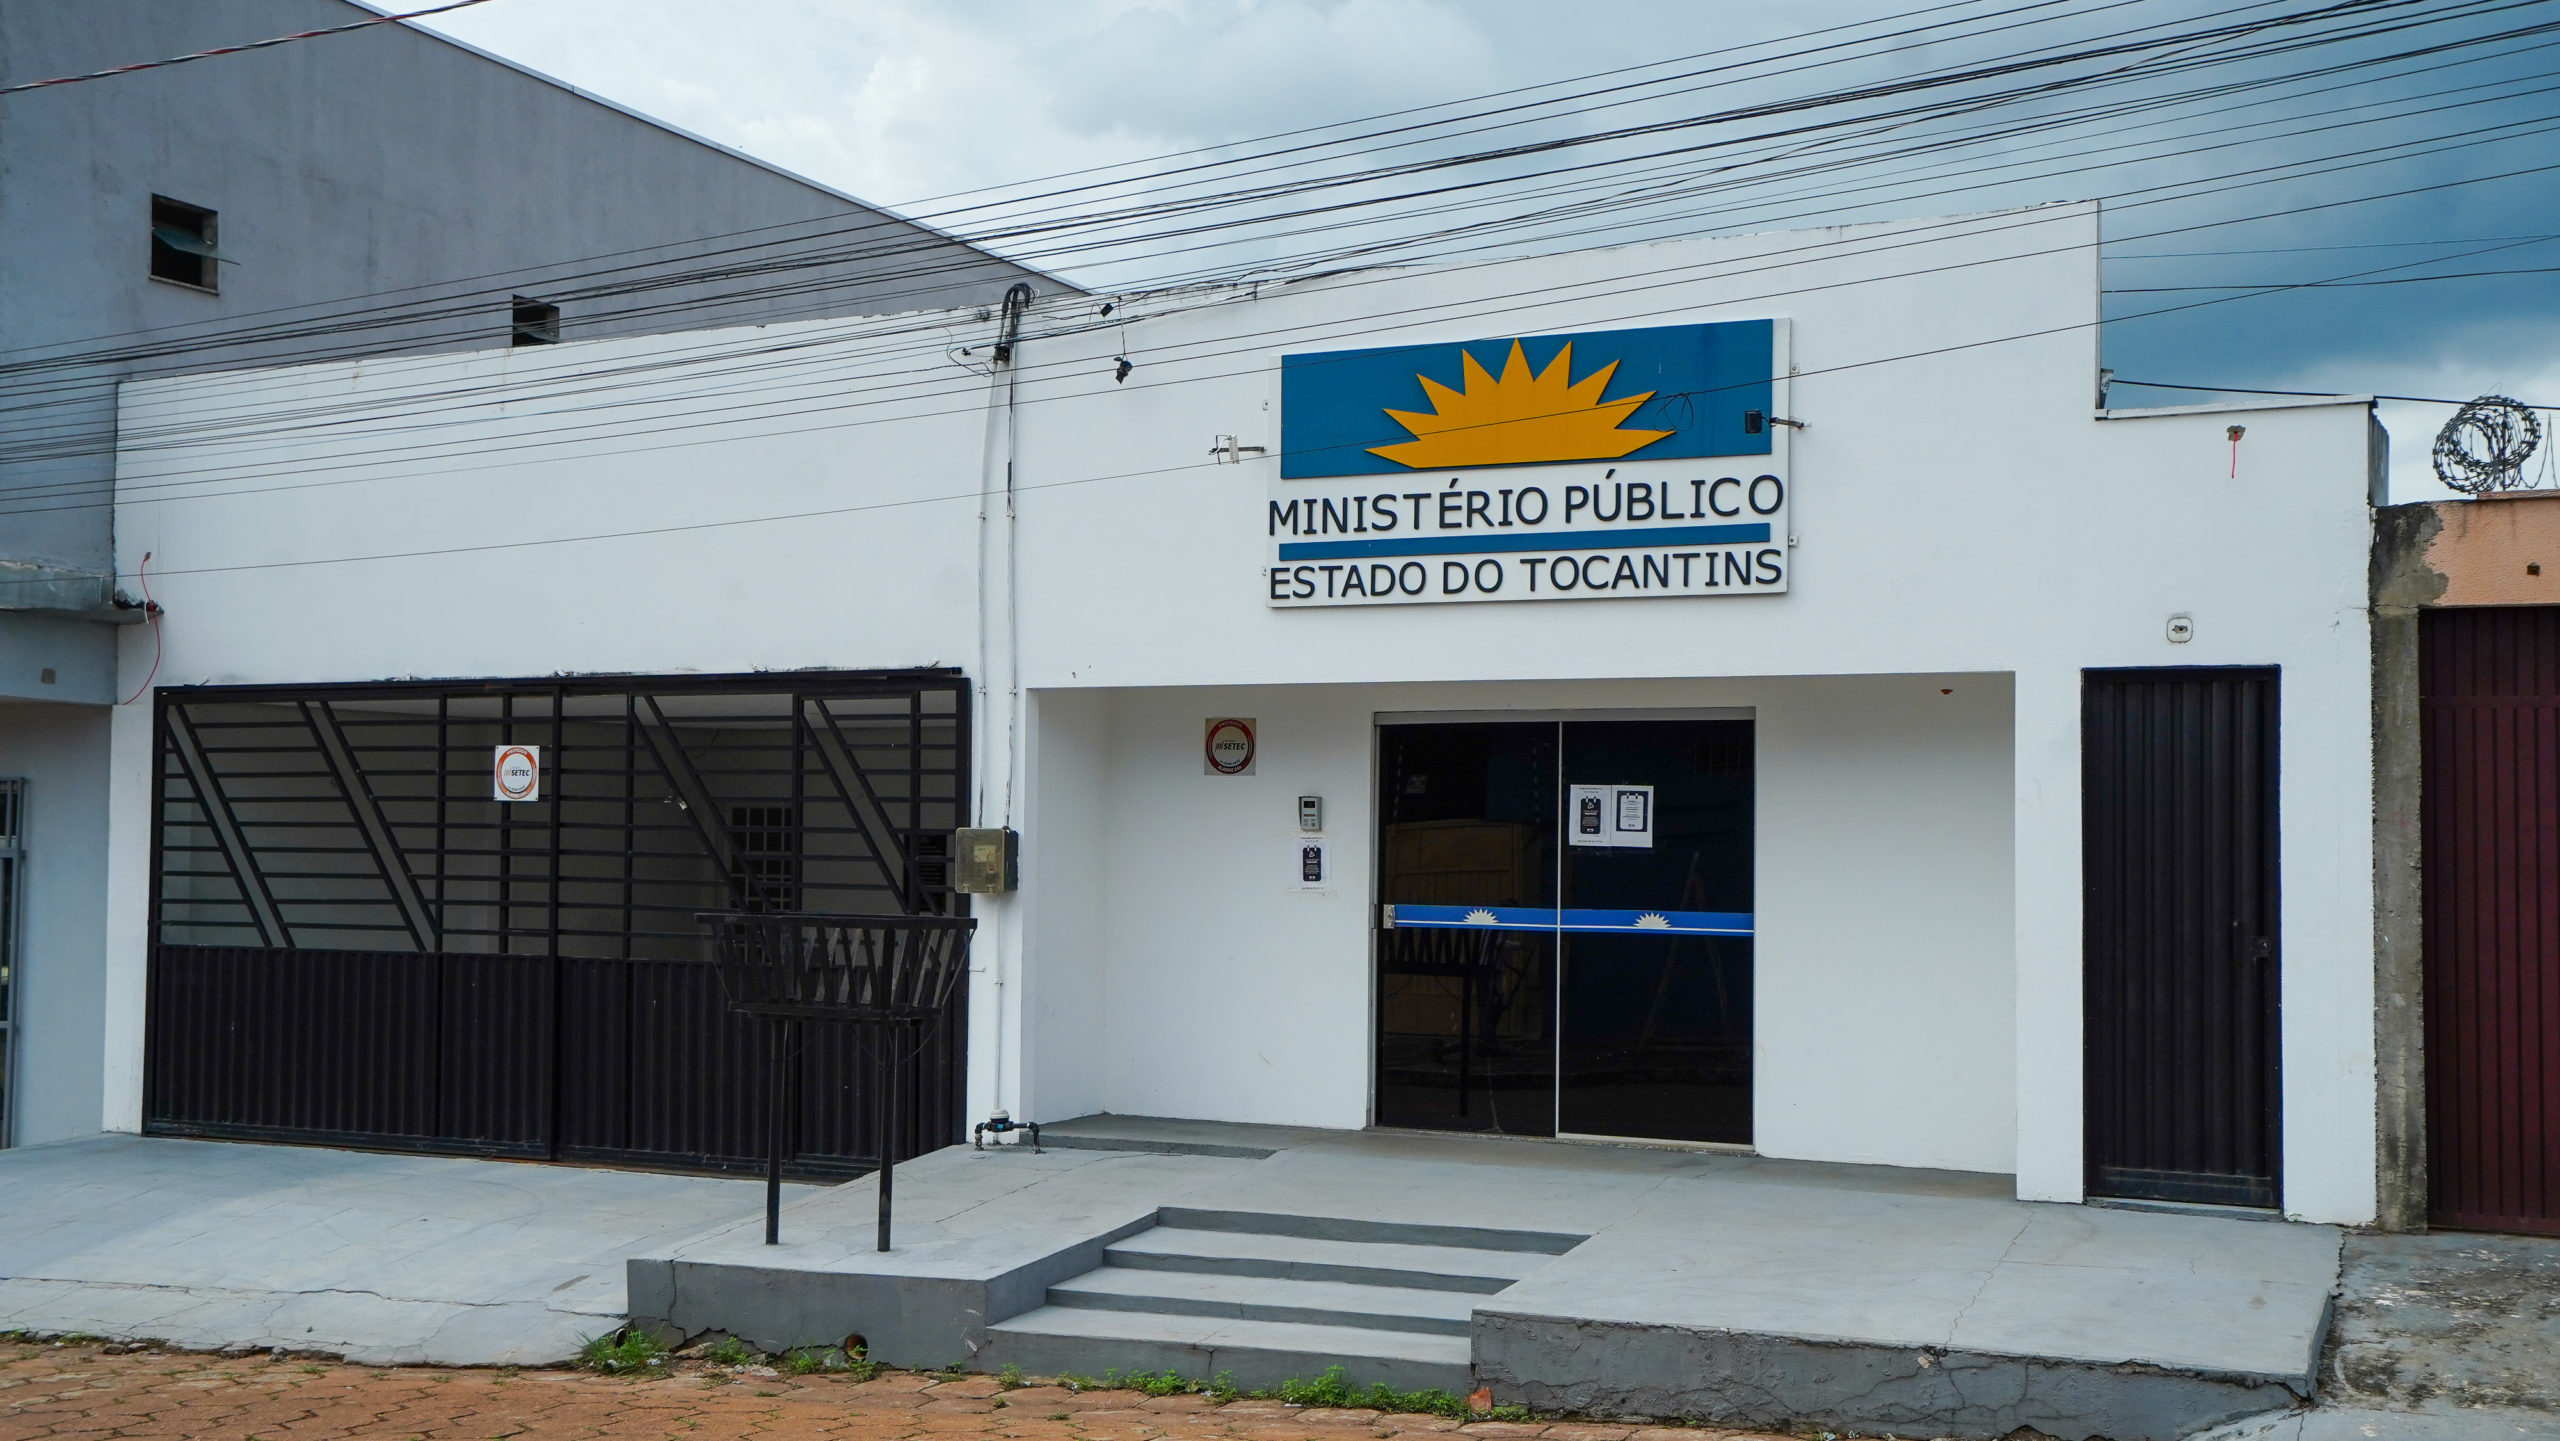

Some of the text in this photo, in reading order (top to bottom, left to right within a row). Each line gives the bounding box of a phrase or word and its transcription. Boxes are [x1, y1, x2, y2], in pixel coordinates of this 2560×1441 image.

[1269, 468, 1784, 536] MINISTÉRIO PÚBLICO
[1270, 548, 1782, 599] ESTADO DO TOCANTINS
[1223, 742, 1245, 750] SETEC
[511, 769, 530, 777] SETEC
